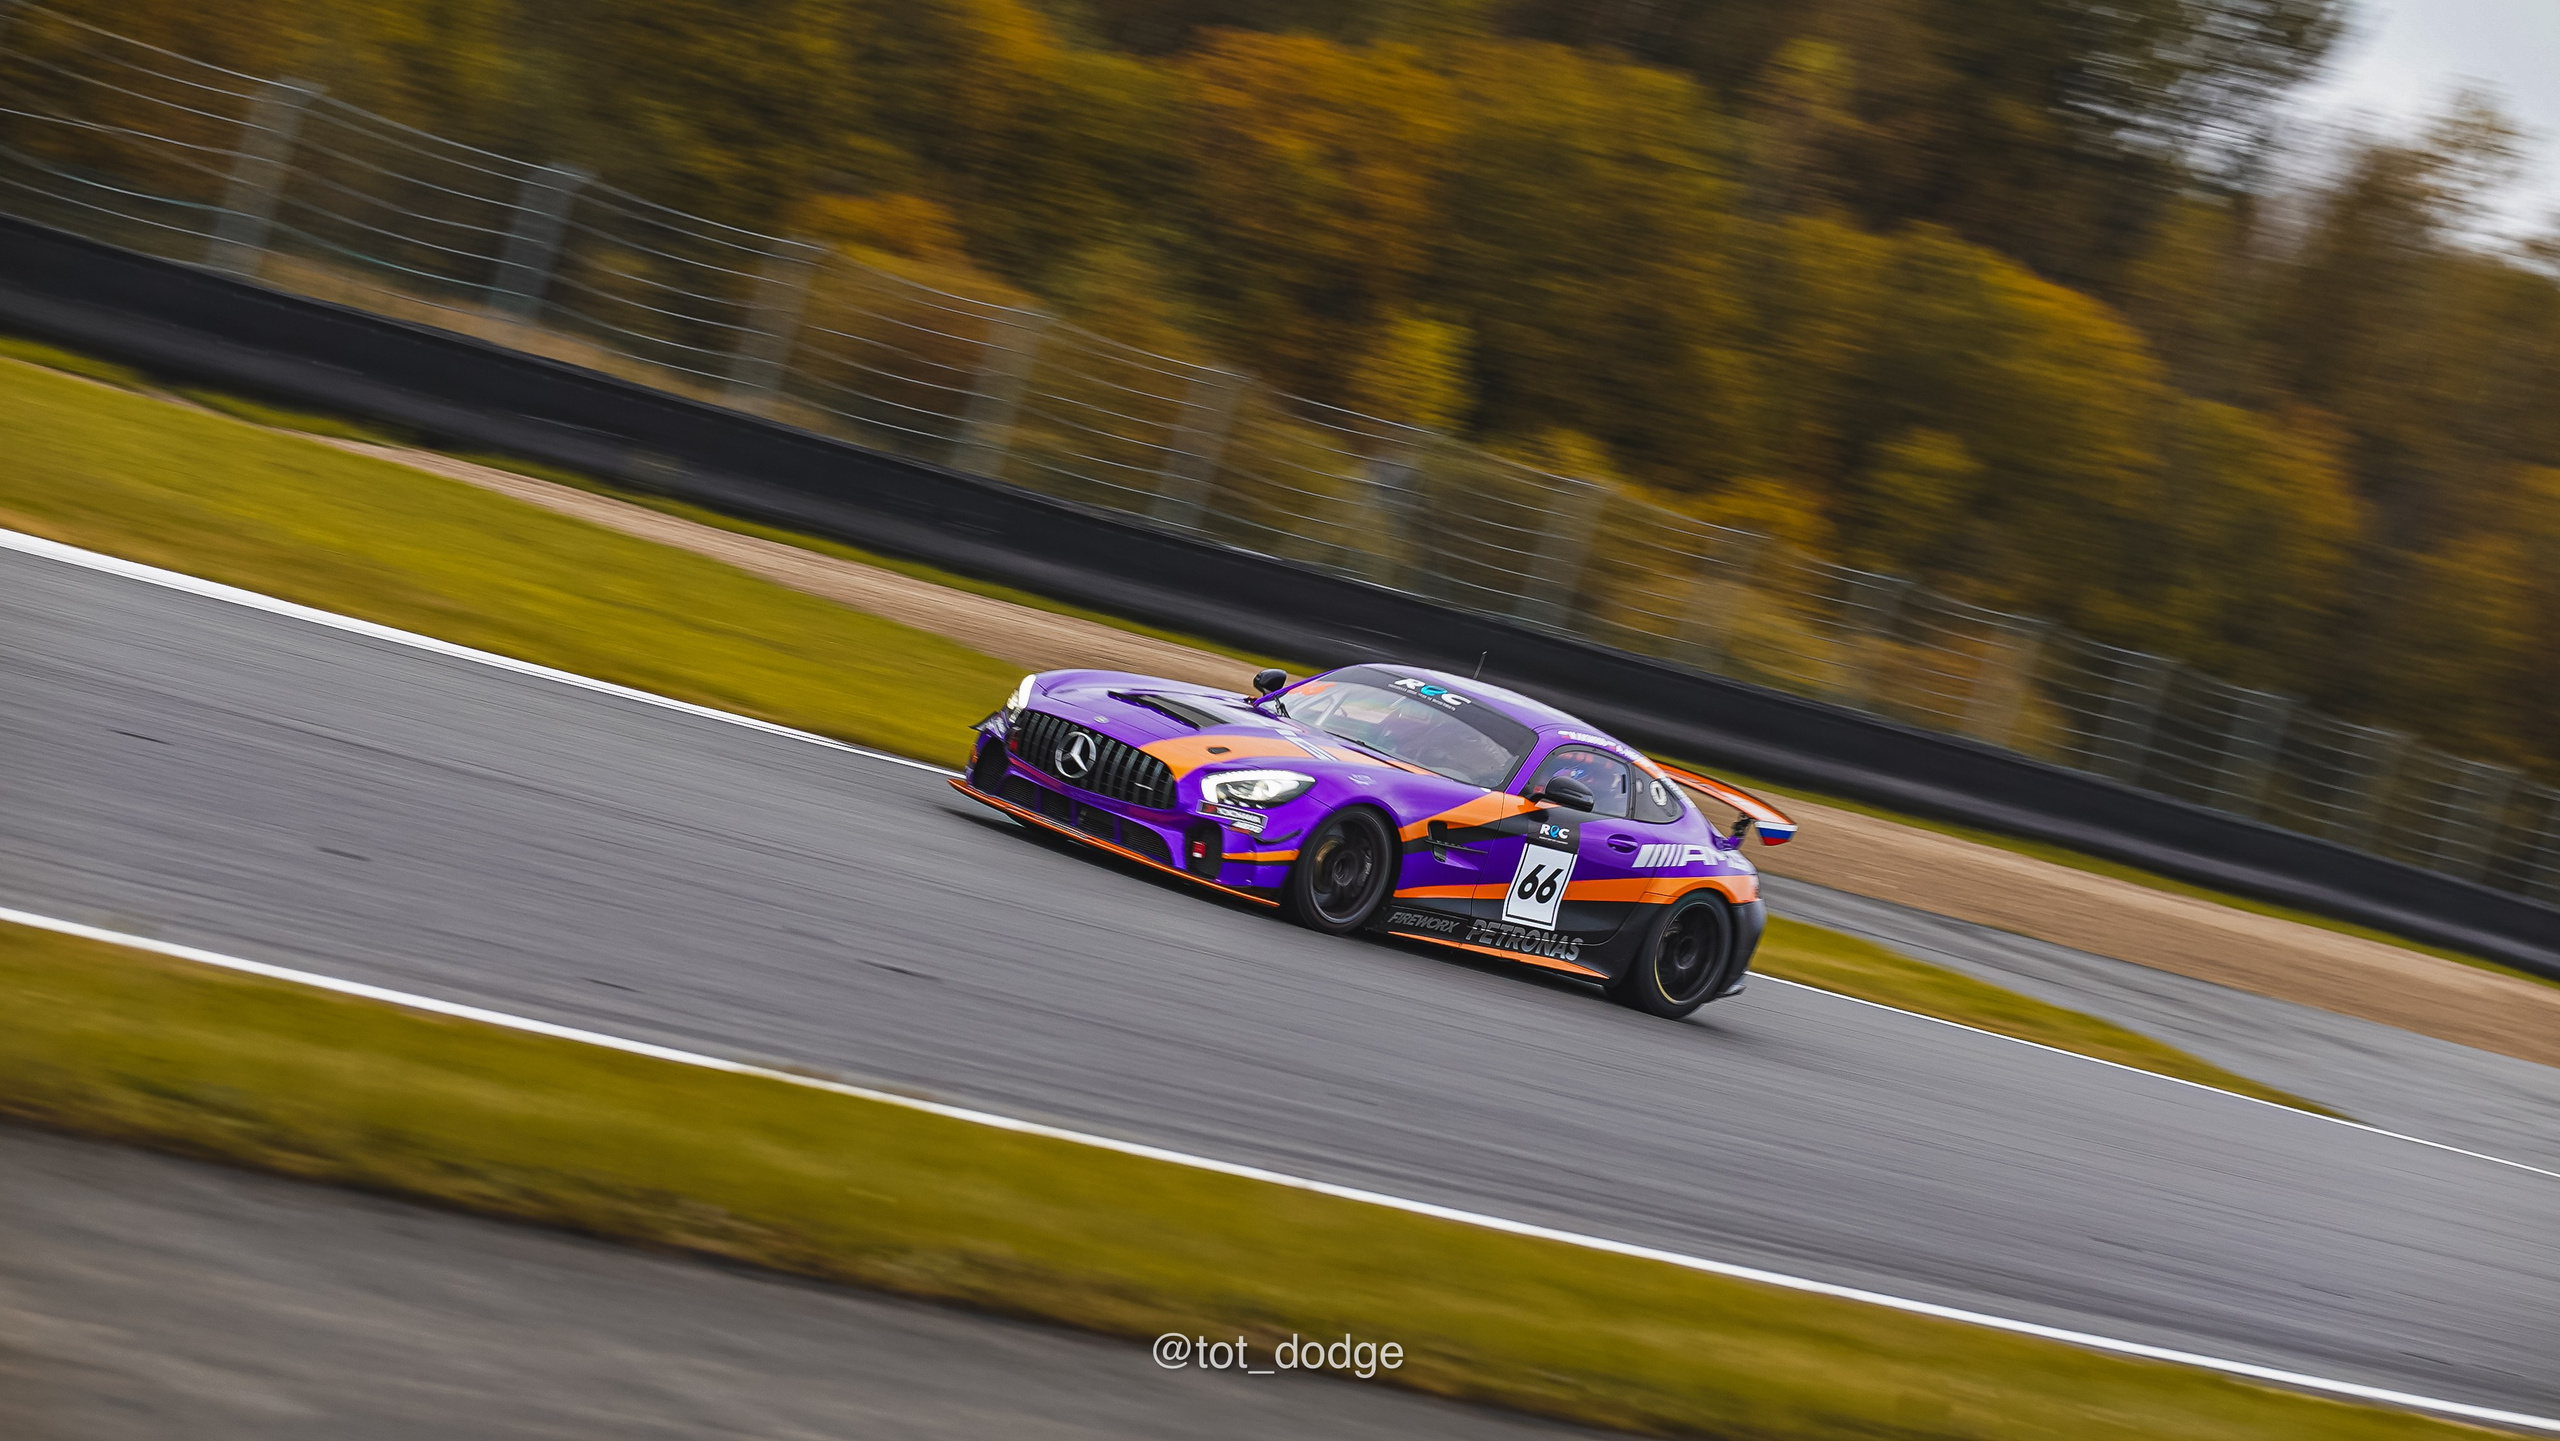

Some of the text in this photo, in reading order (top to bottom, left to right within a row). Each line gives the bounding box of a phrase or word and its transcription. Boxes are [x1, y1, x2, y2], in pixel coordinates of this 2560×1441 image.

[1517, 863, 1565, 904] 66
[1387, 911, 1460, 934] FIREWORX
[1465, 918, 1585, 962] PETRONAS
